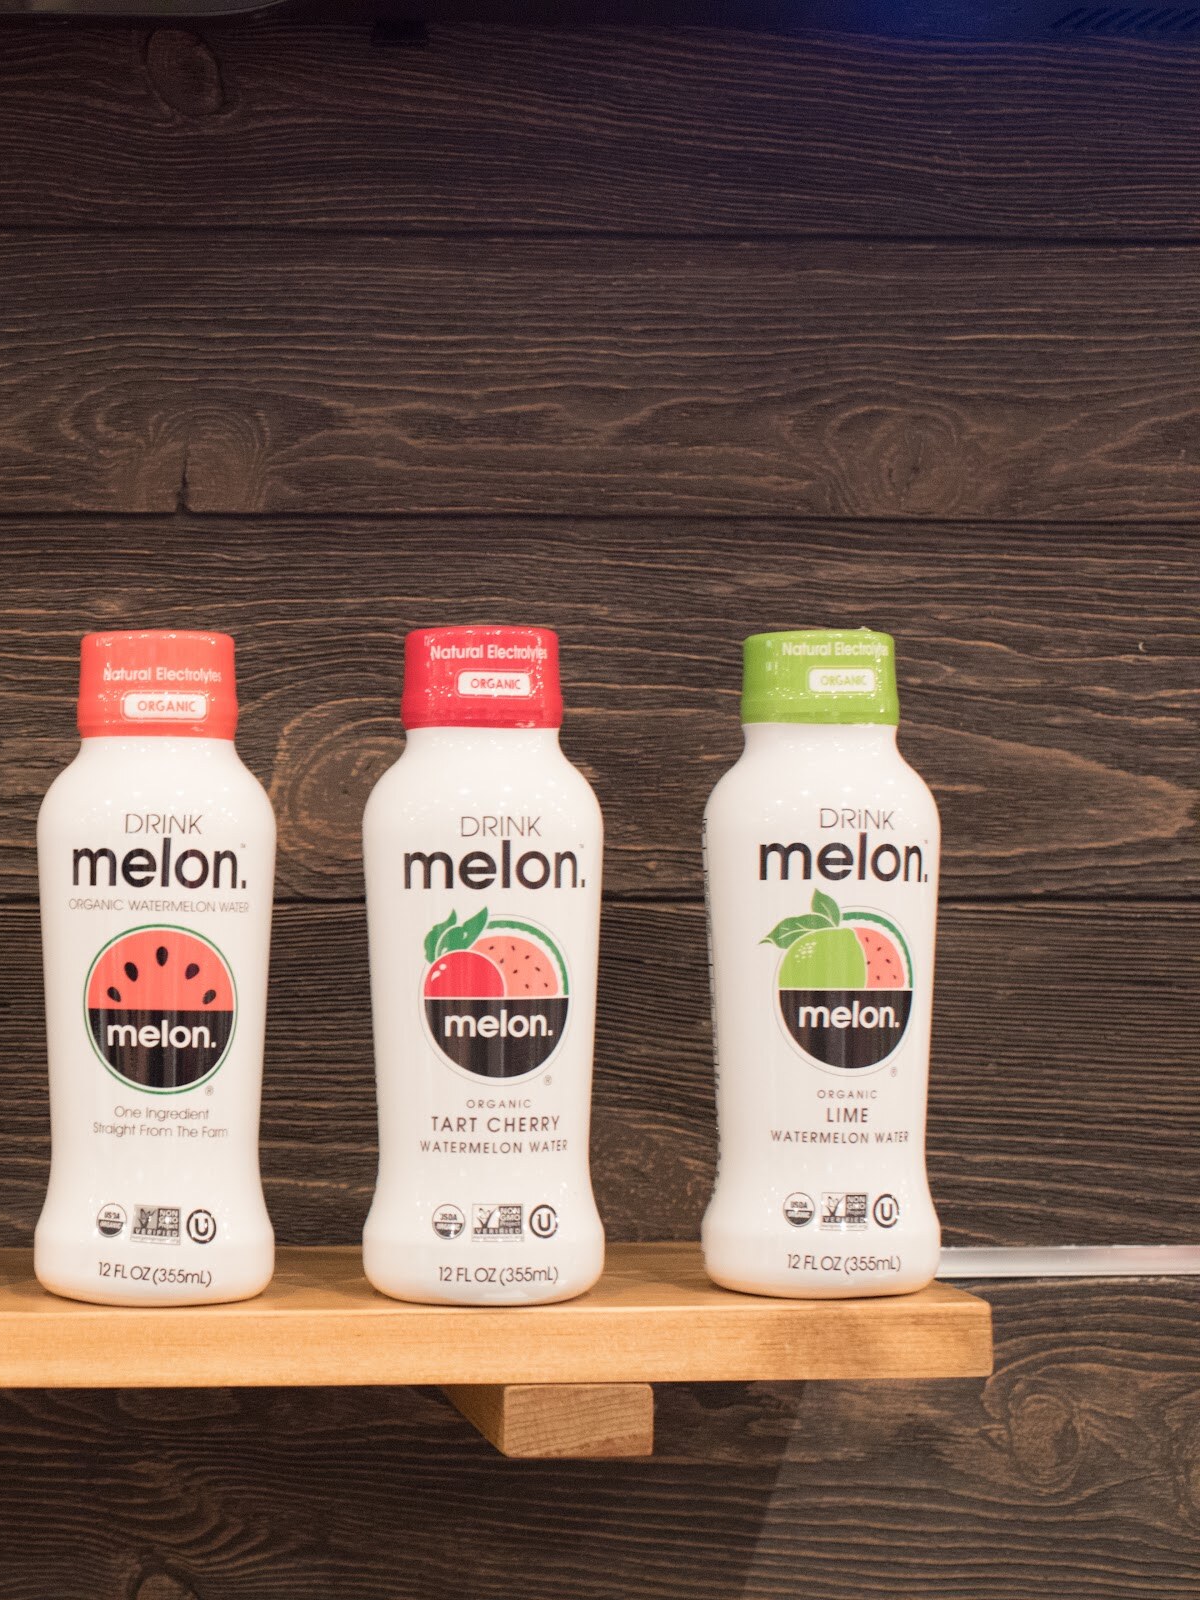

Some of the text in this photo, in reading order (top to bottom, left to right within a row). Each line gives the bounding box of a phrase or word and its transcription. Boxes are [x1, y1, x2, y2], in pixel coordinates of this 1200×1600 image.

[430, 644, 484, 661] Natural
[782, 642, 831, 656] Natural
[103, 666, 222, 684] Natural Electrolytes
[470, 678, 521, 690] ORGANIC
[820, 675, 867, 686] ORGANIC
[137, 700, 196, 712] ORGANIC
[124, 813, 203, 835] DRINK
[460, 816, 542, 837] DRINK
[820, 808, 895, 830] DRINK
[72, 837, 247, 889] melon.
[404, 839, 586, 890] melon.
[759, 832, 928, 883] melon.
[68, 898, 249, 914] ORGANIC WATERMELON WATER
[444, 1010, 553, 1038] melon.
[799, 1001, 900, 1029] melon.
[106, 1020, 217, 1048] melon.
[817, 1089, 877, 1099] ORGANIC
[466, 1099, 532, 1109] ORGANIC
[114, 1106, 209, 1124] One Ingredient
[431, 1115, 560, 1133] TART CHERRY
[827, 1107, 869, 1123] LIME
[92, 1122, 229, 1139] Straight From The Farm
[770, 1129, 909, 1144] WATERMELON WATER
[420, 1139, 569, 1154] WATERMELON WATER
[159, 1209, 179, 1217] NON
[159, 1216, 178, 1224] GO
[787, 1254, 902, 1275] 12 FL OZ (355mL)
[98, 1261, 212, 1288] 12 FL OZ (355mL)
[439, 1266, 559, 1287] 12 FL OZ (355mL)
